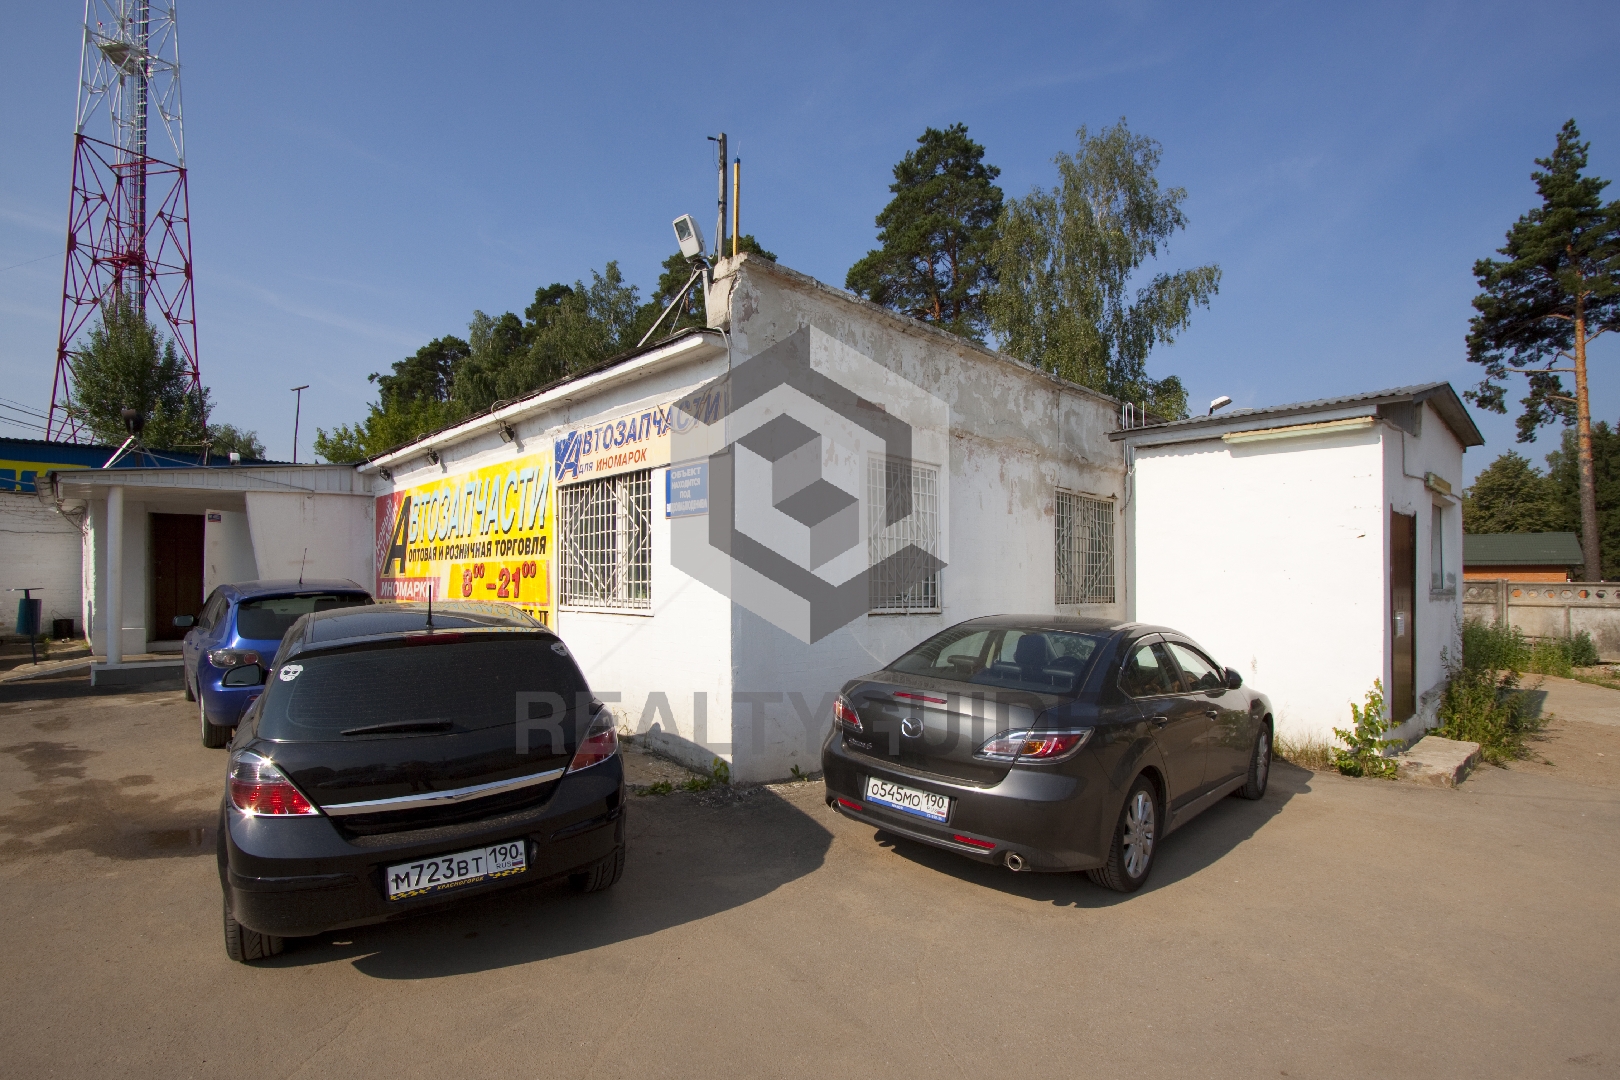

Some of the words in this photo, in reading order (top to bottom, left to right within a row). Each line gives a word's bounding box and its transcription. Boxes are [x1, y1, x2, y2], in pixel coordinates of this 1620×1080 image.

[596, 448, 648, 472] ИНОМАРОК
[671, 467, 701, 479] ОБЪЕКТ
[671, 478, 701, 490] НАХОДИТСЯ
[679, 490, 691, 499] ПОД
[383, 463, 552, 575] АВТОЗАПЧАСТИ
[408, 546, 437, 563] ОПТОВАЯ
[438, 546, 444, 561] И
[445, 540, 492, 561] РОЗНИЧНАЯ
[495, 536, 547, 557] ТОРГОВЛЯ
[924, 793, 945, 809] 190
[394, 857, 483, 890] М723ВТ
[488, 843, 519, 864] 190
[496, 861, 512, 870] RUS
[437, 876, 485, 891] КРАСНОГОРСК
